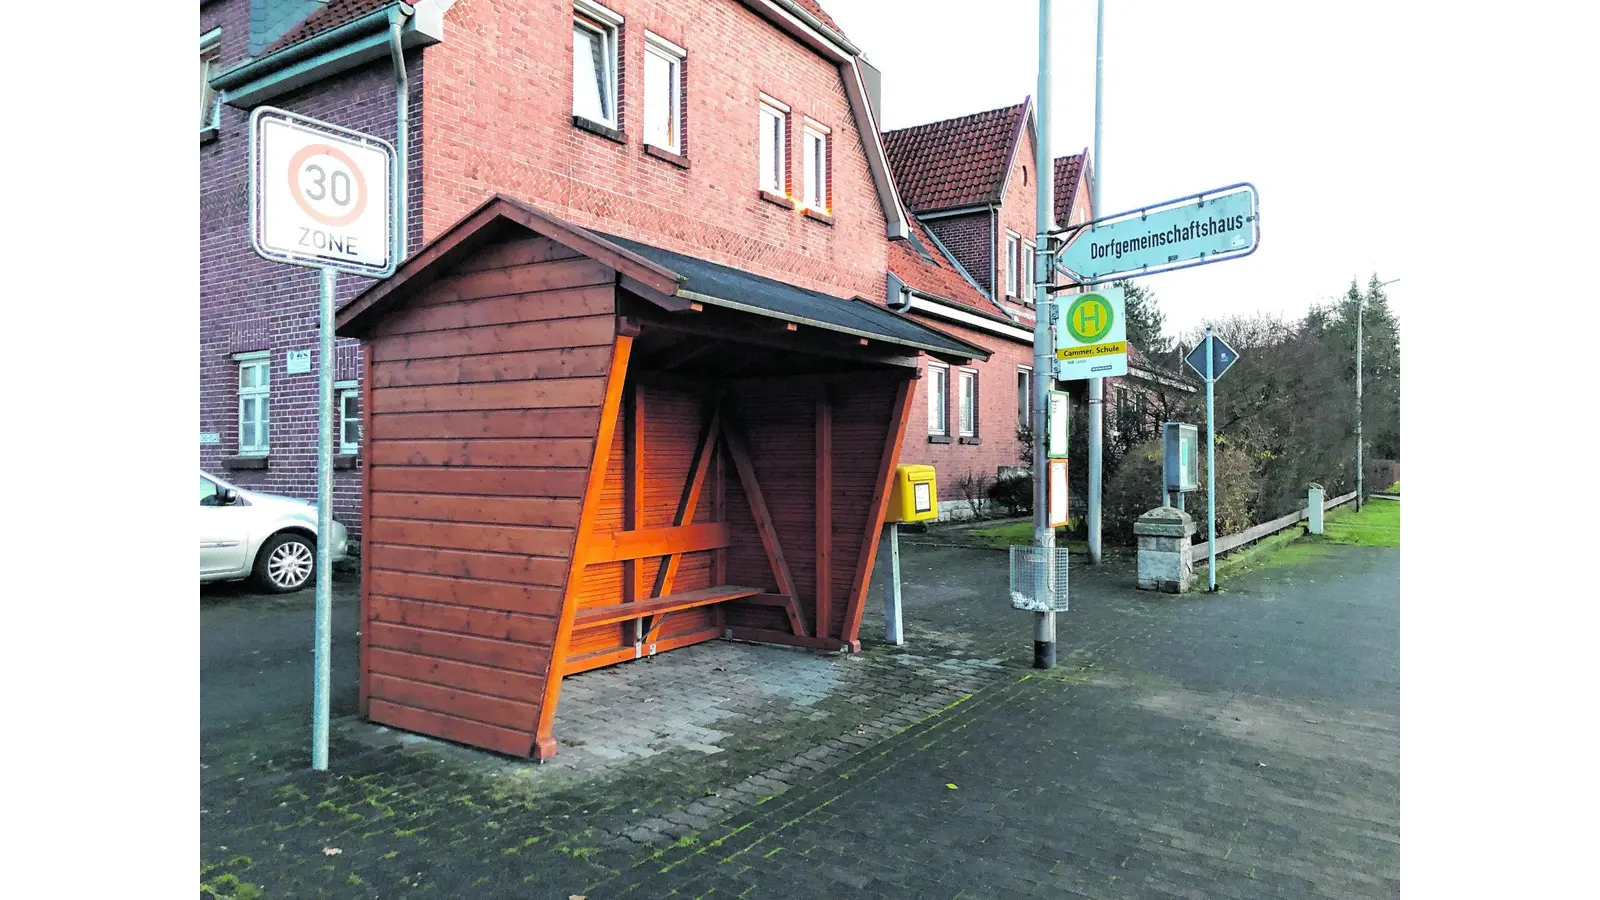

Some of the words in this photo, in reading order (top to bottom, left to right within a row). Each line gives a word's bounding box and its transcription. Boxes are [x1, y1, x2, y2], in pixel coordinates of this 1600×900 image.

[305, 164, 350, 206] 30
[298, 226, 358, 256] ZONE
[1091, 214, 1243, 260] Dorfgemeinschaftshaus
[1080, 303, 1100, 333] H
[1063, 349, 1095, 357] Cammer,
[1096, 345, 1120, 354] Schule
